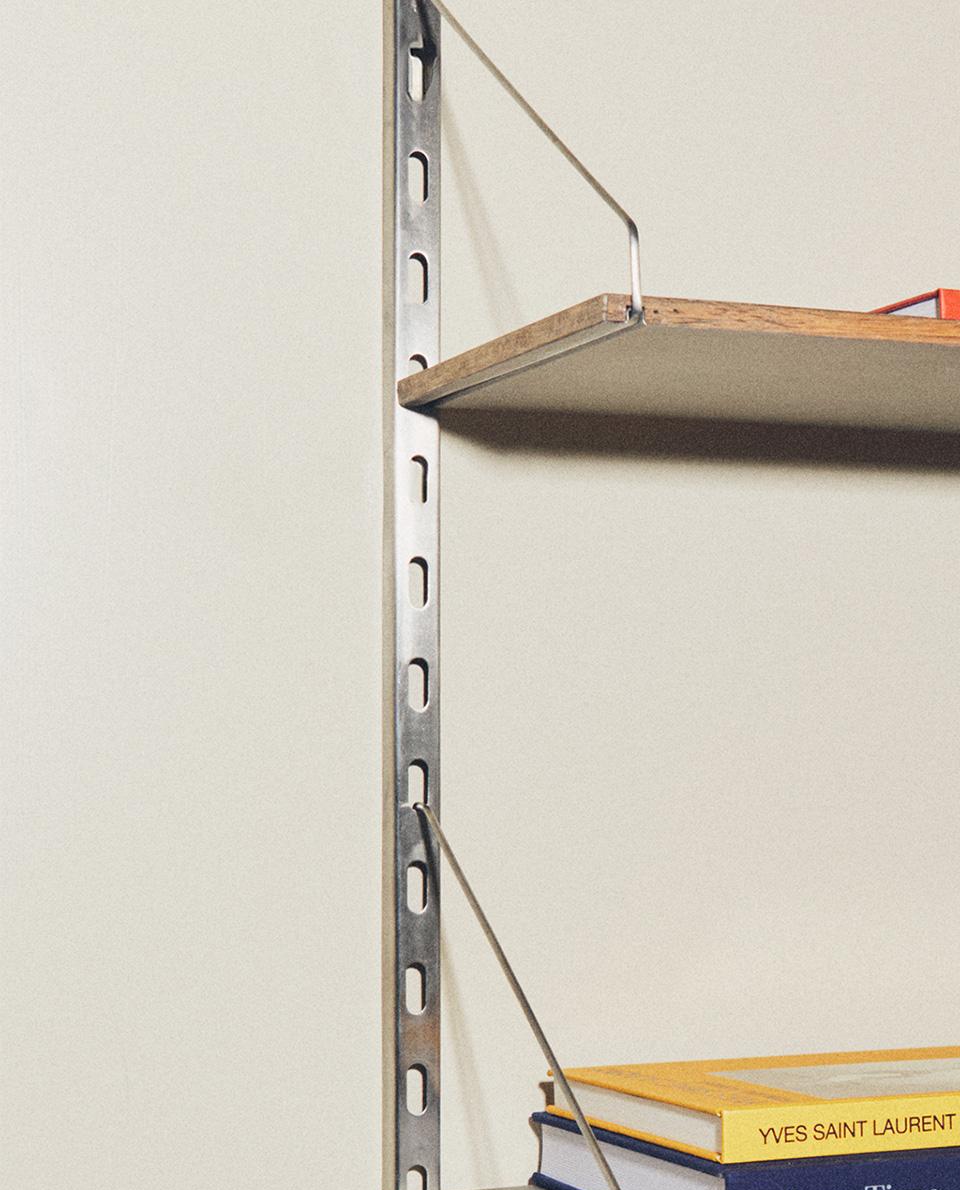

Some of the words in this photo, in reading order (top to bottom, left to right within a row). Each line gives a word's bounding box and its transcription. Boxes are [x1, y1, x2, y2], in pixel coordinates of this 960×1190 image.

[759, 1124, 808, 1145] YVES
[813, 1120, 868, 1141] SAINT
[872, 1113, 957, 1136] LAURENT
